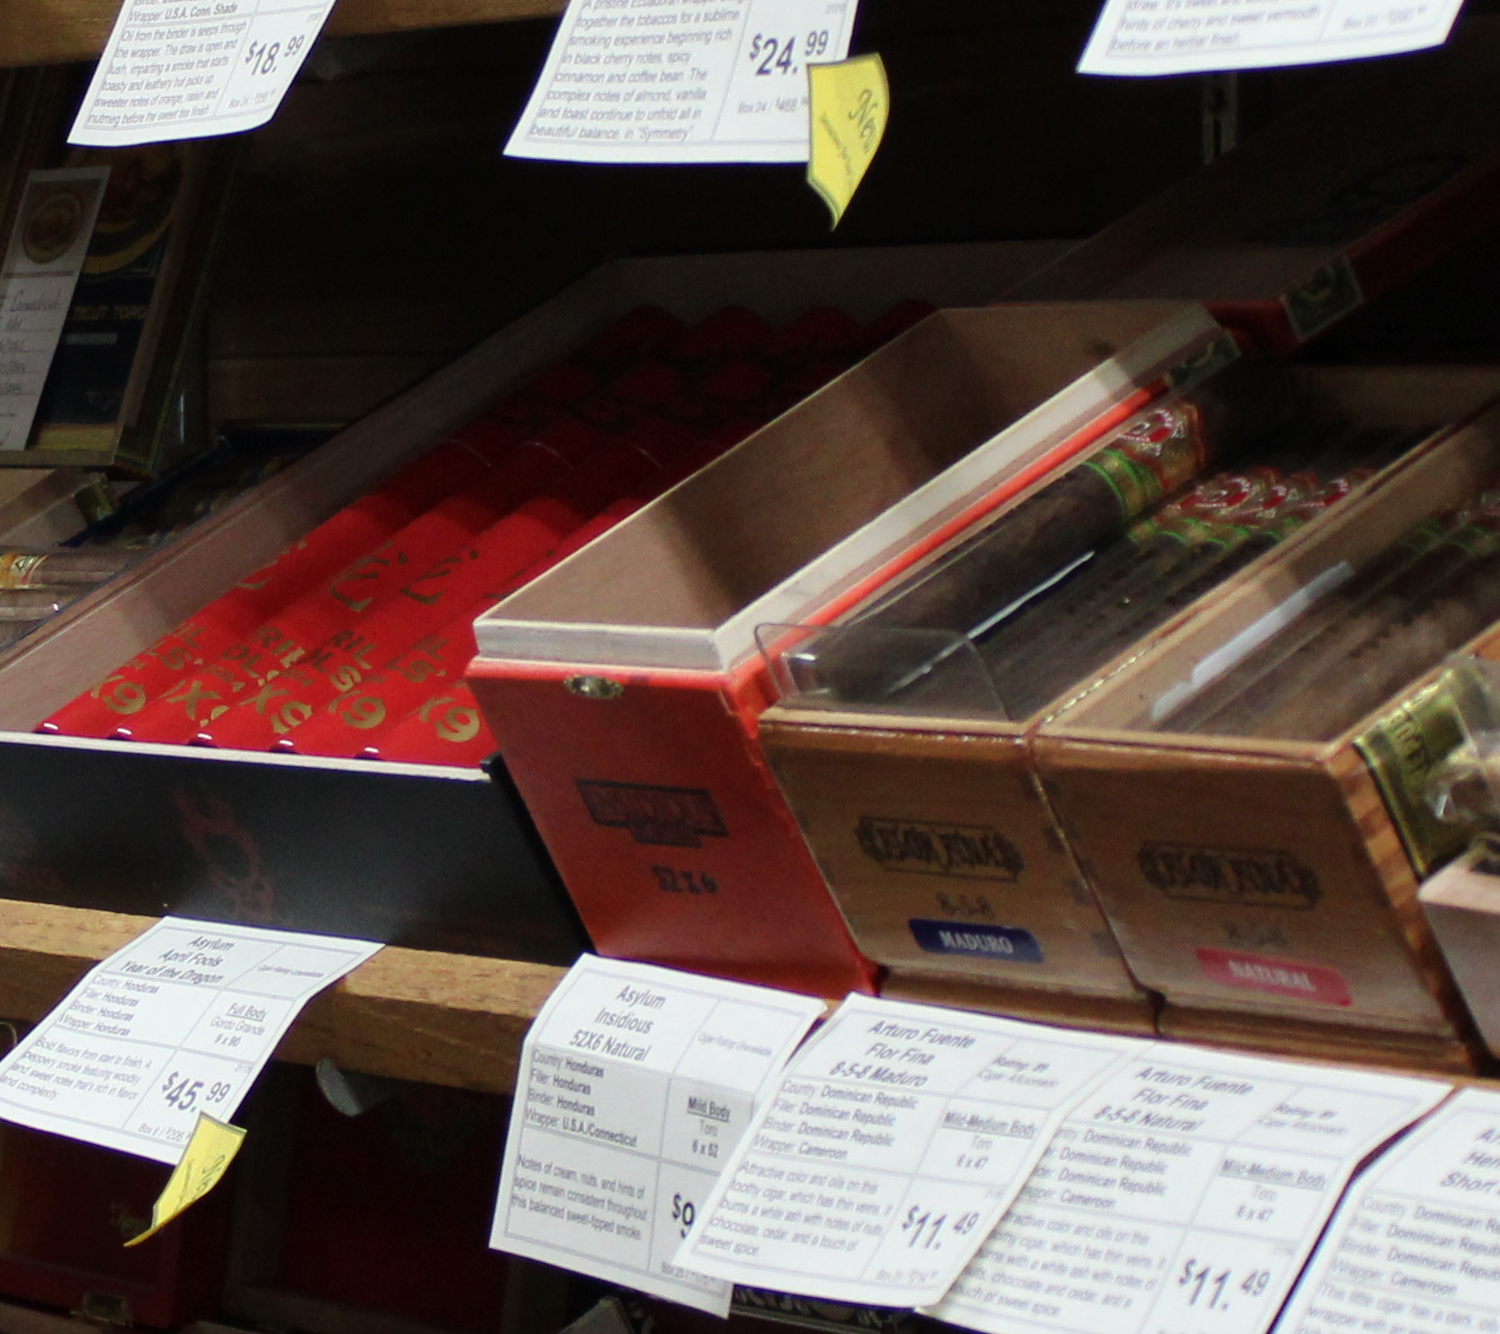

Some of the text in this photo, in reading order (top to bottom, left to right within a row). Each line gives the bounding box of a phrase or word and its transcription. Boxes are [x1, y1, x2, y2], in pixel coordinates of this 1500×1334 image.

[243, 33, 306, 78] $18.99
[749, 30, 828, 76] $24.99
[187, 935, 235, 951] Asylum
[938, 928, 1015, 956] MADURO
[157, 948, 224, 967] April Fools
[119, 959, 224, 985] Year of the Dragon
[1228, 959, 1316, 993] NATURAL
[615, 984, 666, 1008] Asylum
[594, 1007, 653, 1034] Insidious
[867, 1019, 975, 1048] Arturo Fuente
[568, 1028, 651, 1061] 52X6 Natural
[864, 1041, 935, 1065] Flor Fina
[564, 1057, 604, 1078] Honduras
[828, 1060, 928, 1087] 8-5-8 Maduro
[161, 1071, 230, 1118] $45.99
[1439, 1170, 1498, 1192] Short
[901, 1204, 979, 1249] $11.49
[1178, 1258, 1269, 1309] $11.49
